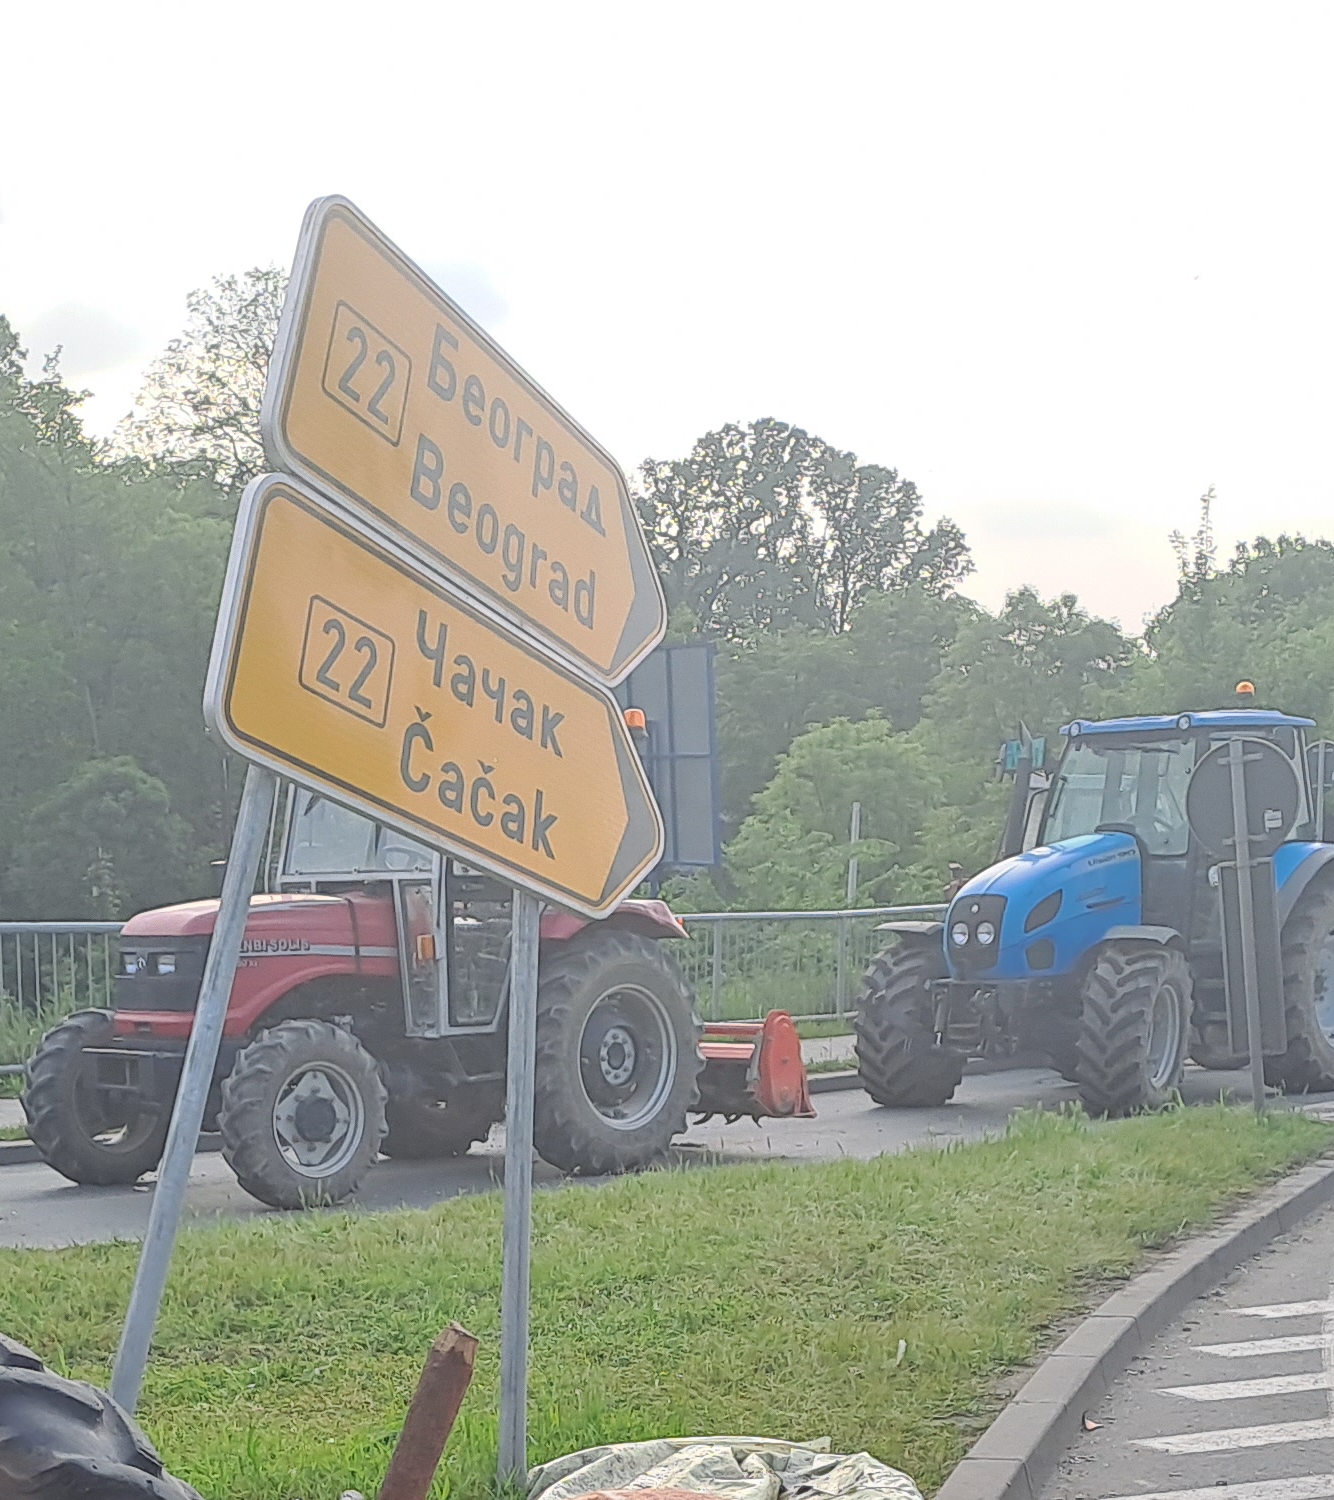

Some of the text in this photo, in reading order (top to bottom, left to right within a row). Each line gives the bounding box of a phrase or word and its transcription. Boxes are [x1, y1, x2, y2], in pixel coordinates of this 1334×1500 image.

[338, 327, 395, 425] 22
[427, 323, 606, 537] Београд
[411, 433, 595, 630] Beograd
[316, 619, 377, 709] 22
[417, 608, 565, 758] Чачак
[400, 705, 558, 860] Čačak
